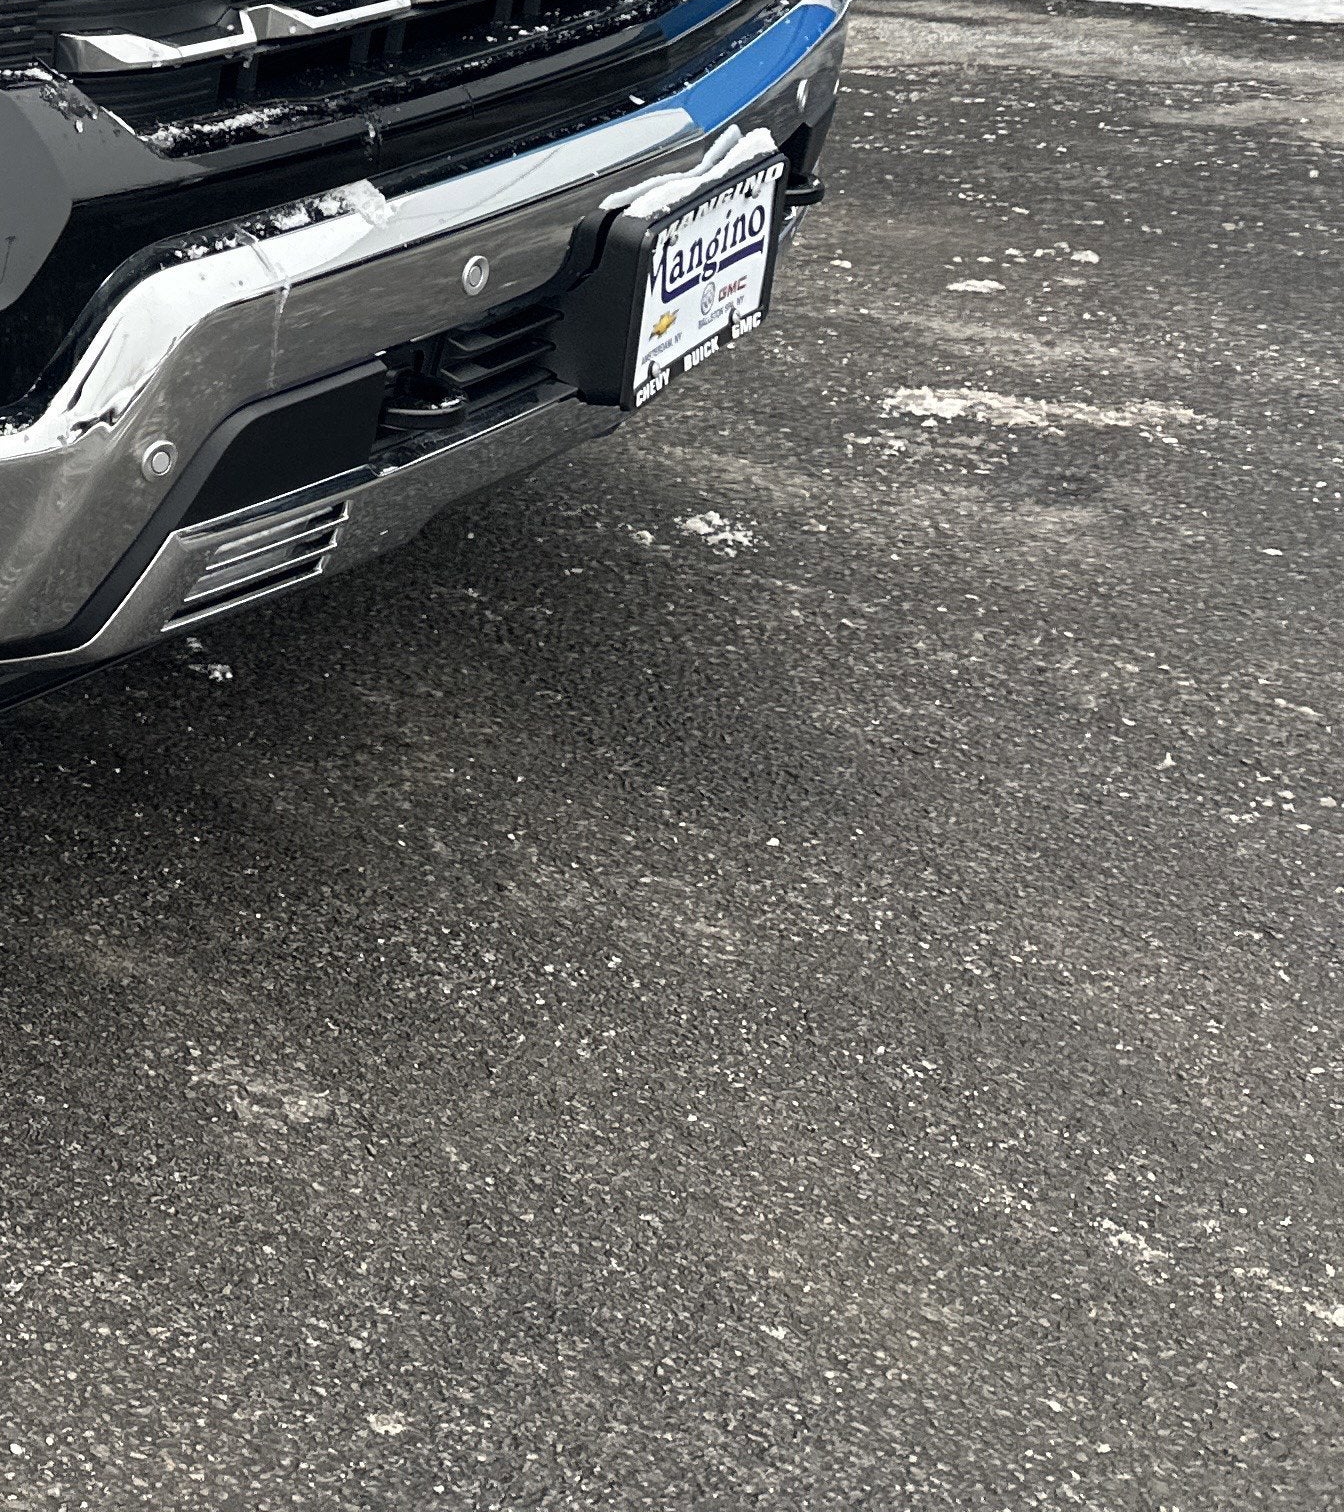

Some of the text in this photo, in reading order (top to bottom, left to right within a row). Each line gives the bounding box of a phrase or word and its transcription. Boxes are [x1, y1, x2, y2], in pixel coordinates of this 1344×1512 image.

[654, 161, 785, 248] MANGINO
[650, 204, 766, 304] Mangino
[718, 275, 748, 303] GMC
[635, 311, 762, 408] CHEVY BUICK GMC
